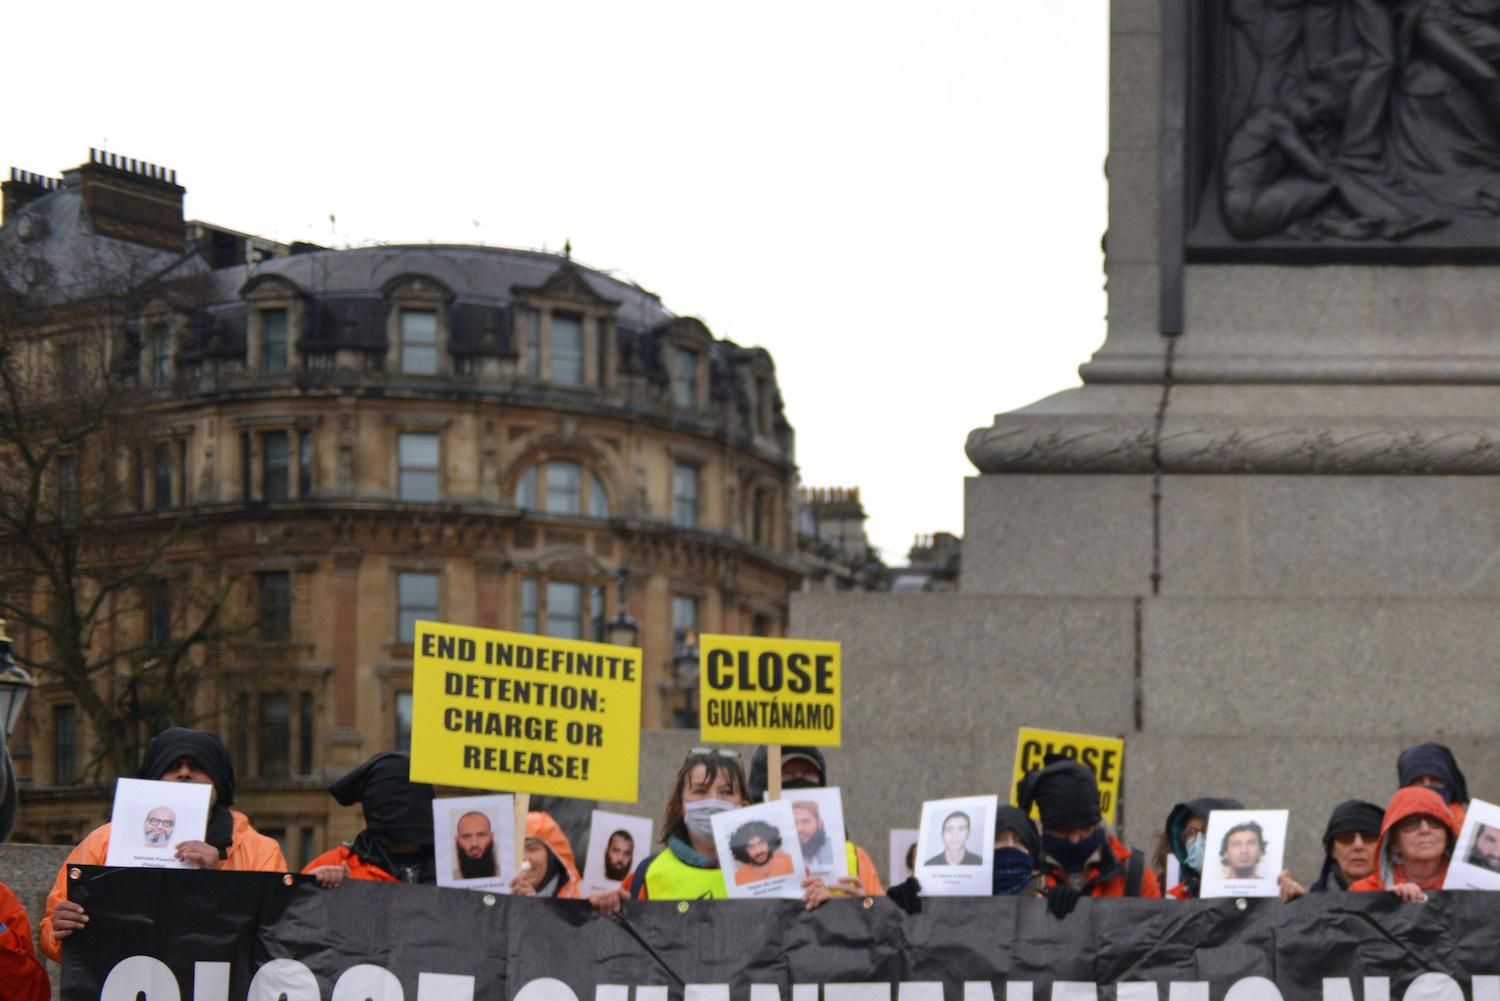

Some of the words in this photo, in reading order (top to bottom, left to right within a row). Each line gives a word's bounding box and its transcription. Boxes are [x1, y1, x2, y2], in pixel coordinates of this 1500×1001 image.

[421, 633, 477, 662] END
[485, 641, 636, 682] INDEFINITE
[707, 648, 834, 694] CLOSE
[444, 672, 606, 713] DETENTION:
[443, 707, 558, 742] CHARGE
[566, 721, 604, 747] OR
[707, 696, 834, 731] GUANTÁNAMO
[463, 745, 589, 780] RELEASE!
